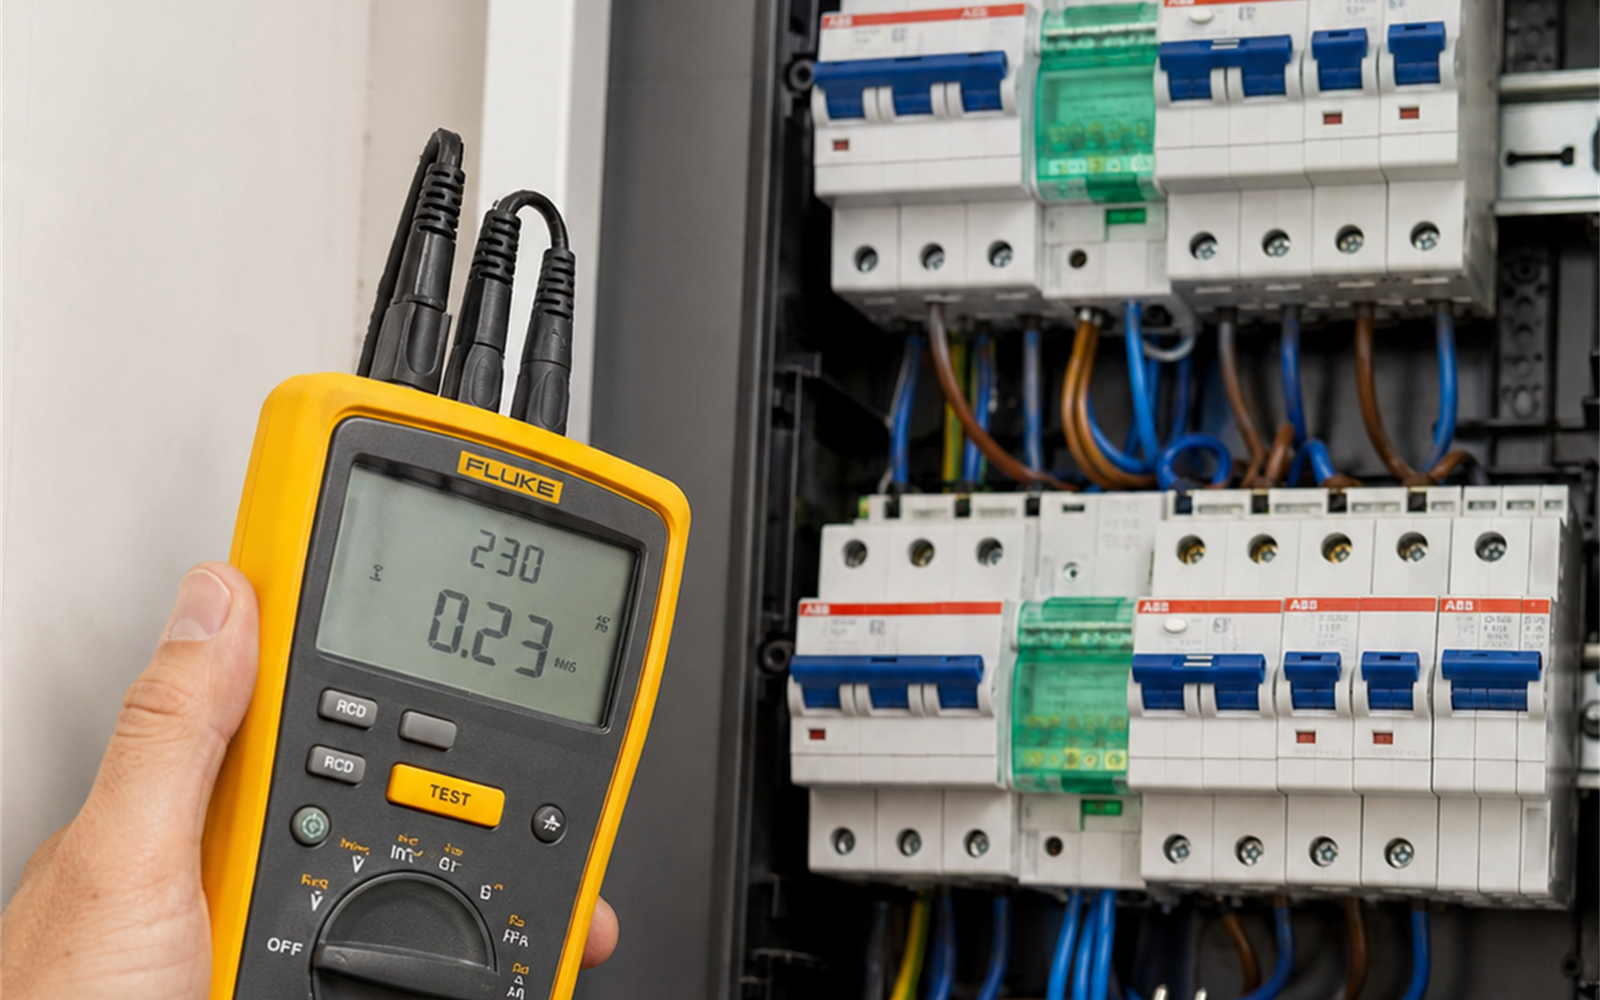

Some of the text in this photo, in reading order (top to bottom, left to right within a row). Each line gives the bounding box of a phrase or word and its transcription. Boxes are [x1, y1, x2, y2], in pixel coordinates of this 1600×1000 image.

[466, 457, 555, 498] FLUKE
[470, 529, 545, 584] 230
[1142, 601, 1170, 613] ABB
[1289, 599, 1318, 611] ABB
[1444, 600, 1474, 611] ABB
[427, 588, 554, 679] 0.23
[336, 700, 366, 718] RCD
[324, 755, 354, 773] RCD
[430, 784, 471, 806] TEST
[267, 937, 304, 956] OFF
